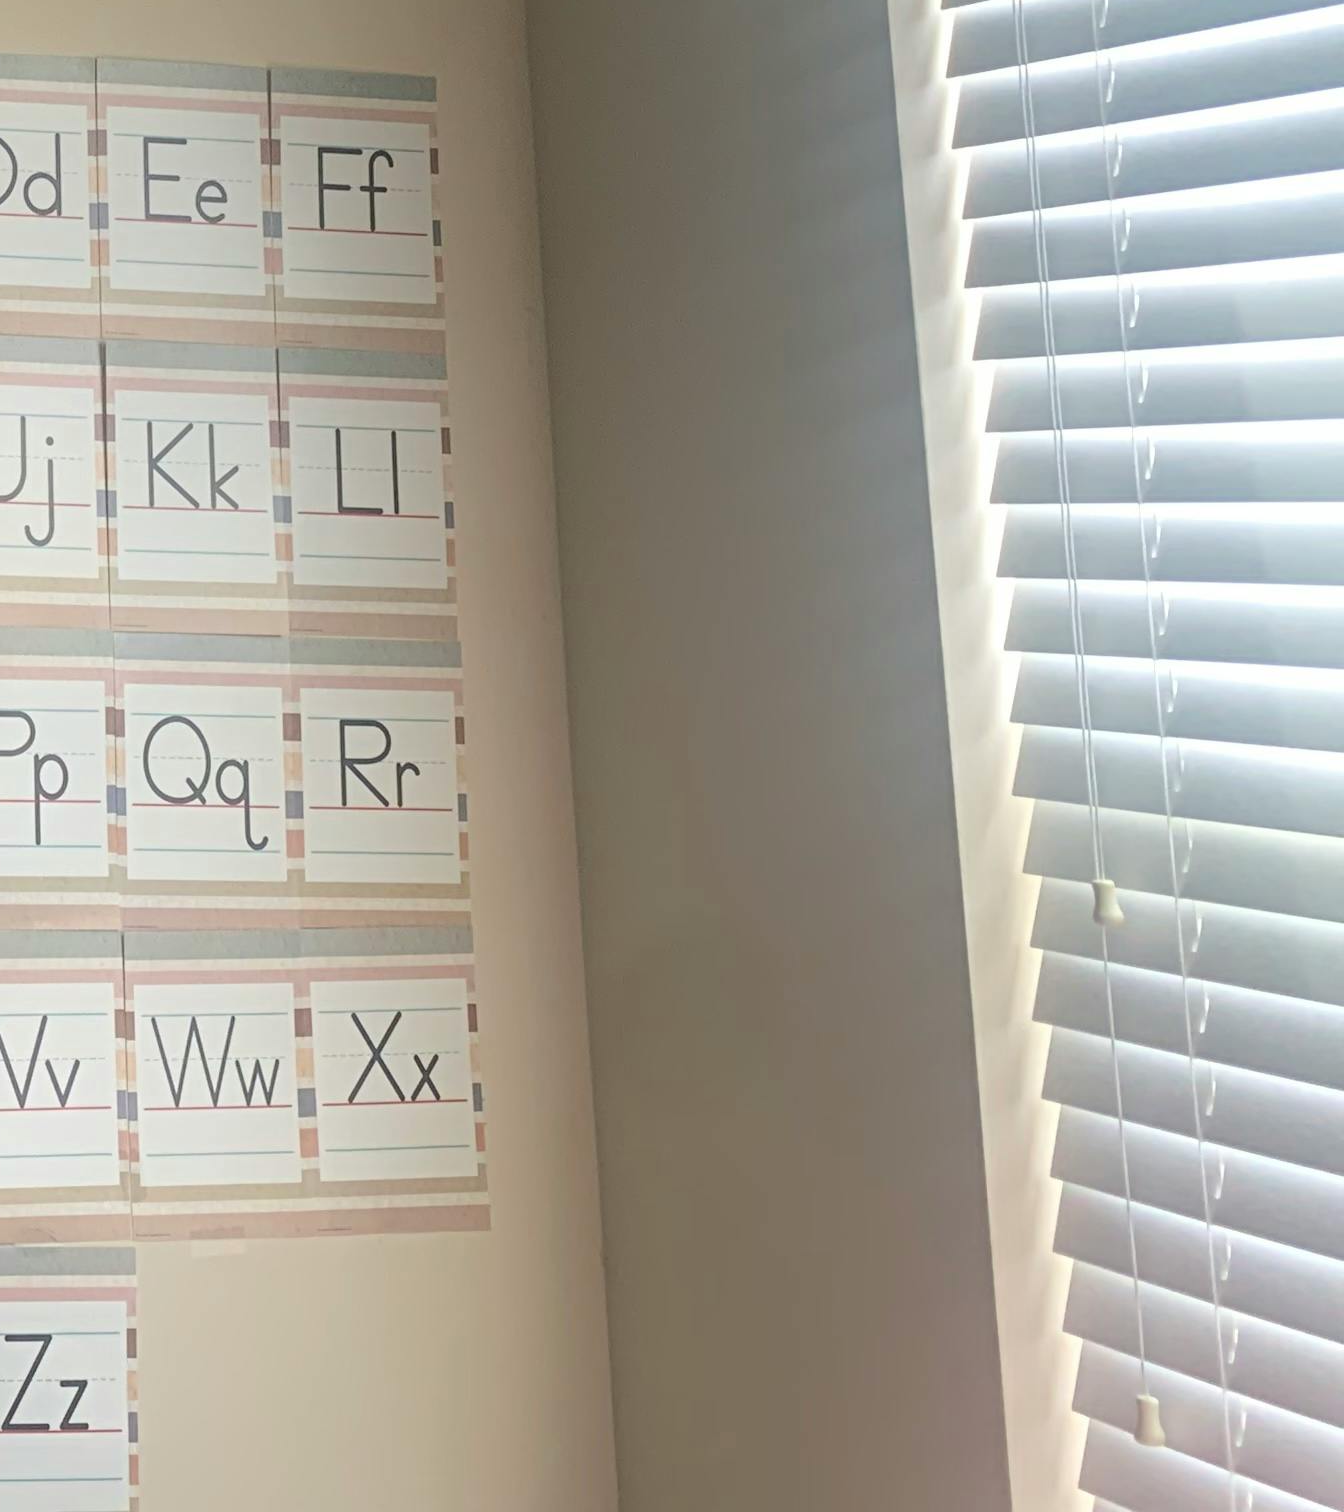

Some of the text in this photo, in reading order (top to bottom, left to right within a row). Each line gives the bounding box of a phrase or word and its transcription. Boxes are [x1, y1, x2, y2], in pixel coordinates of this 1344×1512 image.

[143, 136, 229, 224] Ee
[317, 146, 395, 232] Ff
[147, 421, 241, 510] Kk
[335, 428, 400, 515] Ll
[143, 715, 269, 851] Qq
[339, 718, 422, 808] Rr
[151, 1015, 281, 1108] Ww
[347, 1010, 445, 1105] Xx
[1, 1334, 90, 1431] Zz
